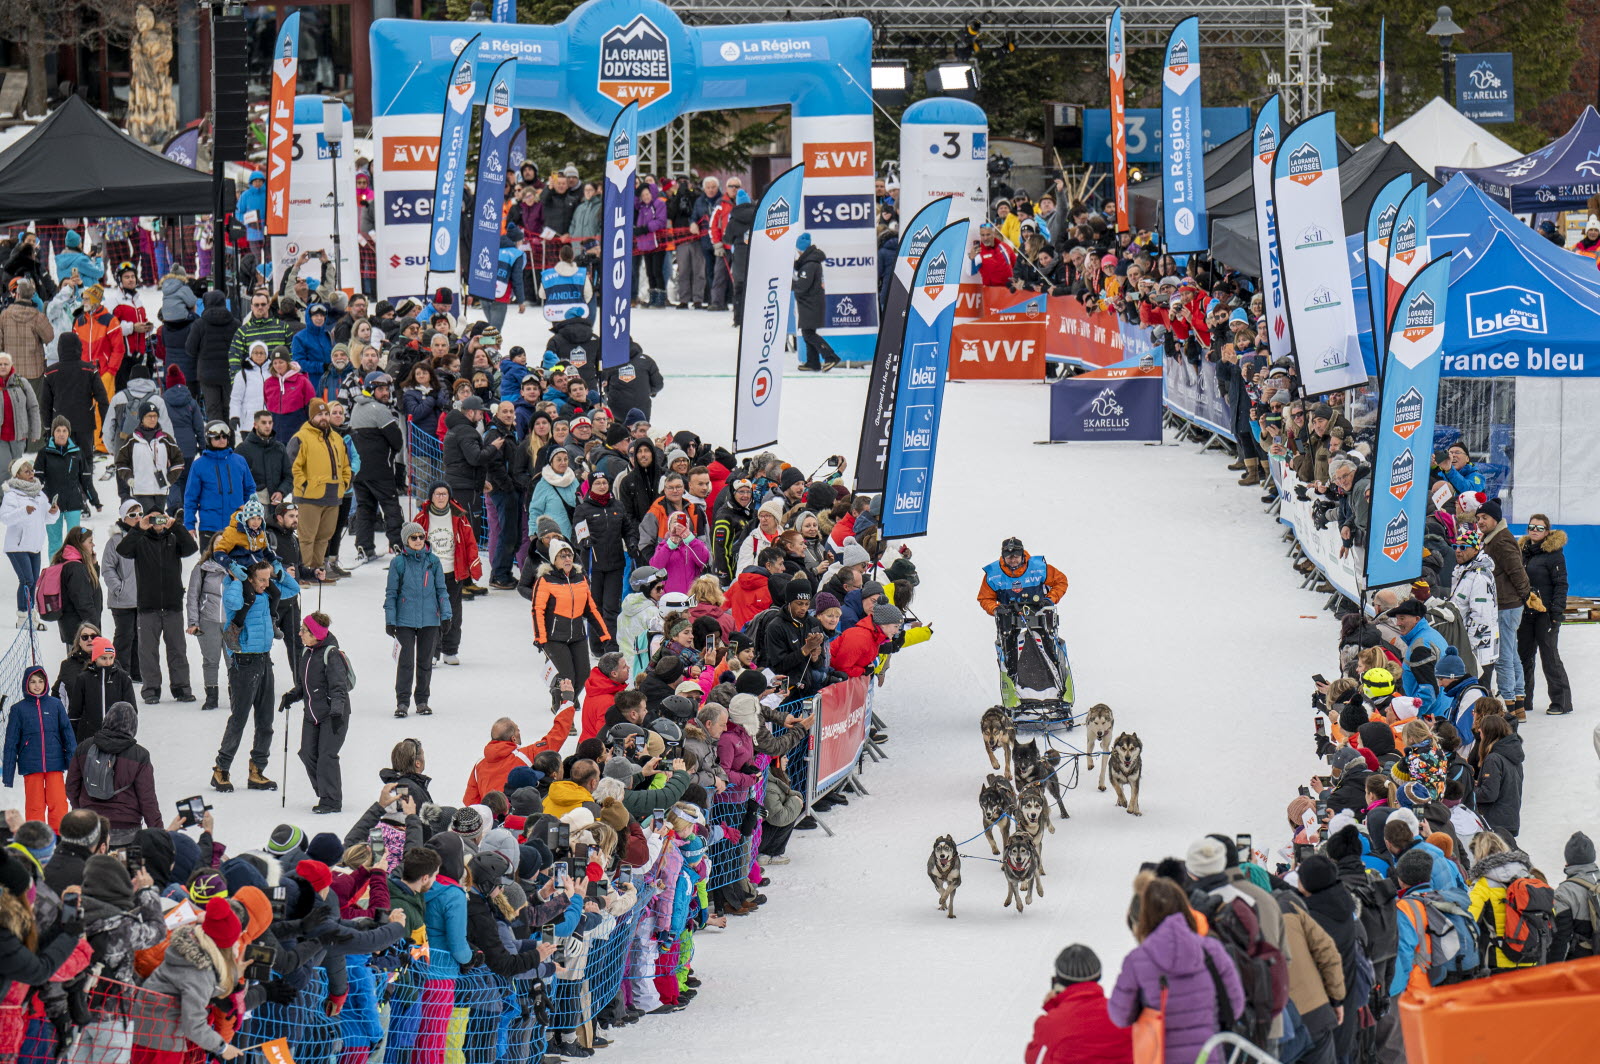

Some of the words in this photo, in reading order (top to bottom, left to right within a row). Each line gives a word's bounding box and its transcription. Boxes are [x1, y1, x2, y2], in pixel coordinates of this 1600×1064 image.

[491, 40, 542, 54] Région
[742, 41, 759, 53] La
[761, 38, 811, 53] Région
[604, 48, 620, 61] LA
[620, 48, 666, 61] GRANDE
[604, 61, 667, 77] ODYSSÉE
[628, 86, 656, 98] VVF
[1467, 90, 1508, 100] KARELLIS
[270, 99, 290, 181] VVF
[1125, 116, 1147, 154] 3
[1170, 106, 1185, 176] Région
[410, 145, 441, 162] VV
[942, 131, 961, 160] 3
[831, 151, 867, 169] VVF
[1291, 162, 1321, 173] ODYSSÉE
[1298, 156, 1319, 166] GRANDE
[437, 199, 447, 223] La
[443, 126, 461, 195] Région
[1172, 179, 1185, 204] La
[1304, 230, 1322, 243] scil
[825, 256, 874, 268] SUZUKI
[1265, 199, 1282, 309] SUZUKI
[1313, 291, 1331, 305] scil
[758, 276, 779, 364] location
[1406, 315, 1433, 326] DYSSÉE
[1410, 309, 1433, 317] GRANDE
[1509, 308, 1538, 319] france
[1475, 313, 1540, 334] bleu
[982, 339, 1036, 362] VVF
[1323, 353, 1341, 366] scil
[1527, 347, 1584, 371] bleu
[911, 368, 936, 385] bleu
[875, 391, 885, 427] Designed
[885, 353, 893, 370] Alps
[1396, 411, 1420, 422] ODYSSÉE
[1401, 404, 1421, 413] GRANDE
[1088, 418, 1130, 428] KARELLIS
[905, 430, 930, 448] bleu
[896, 493, 922, 510] bleu
